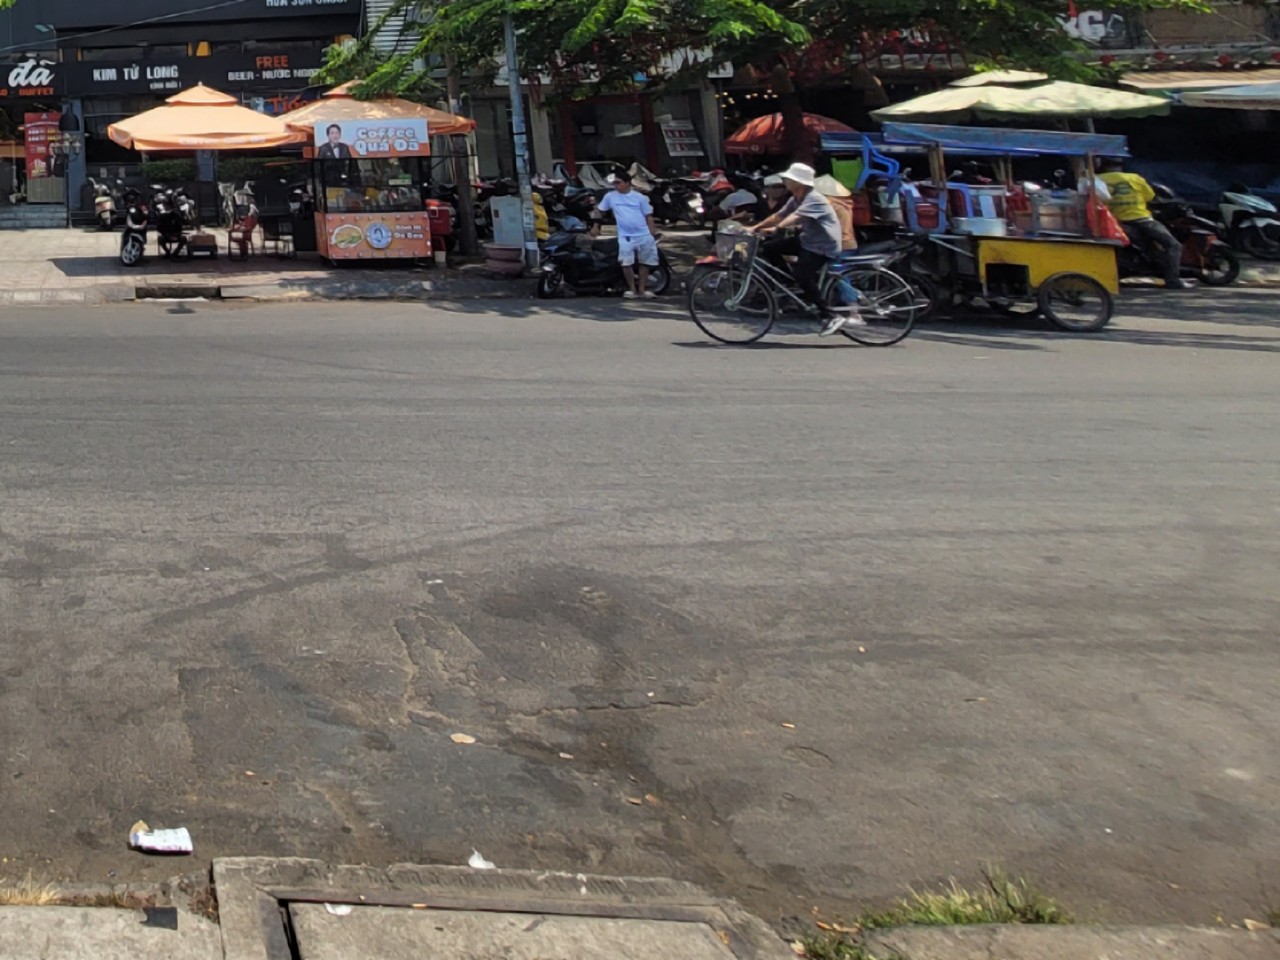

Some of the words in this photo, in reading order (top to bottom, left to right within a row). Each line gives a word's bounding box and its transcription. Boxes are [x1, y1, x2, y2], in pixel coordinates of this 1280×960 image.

[255, 55, 288, 69] FREE
[8, 58, 57, 88] đã
[93, 68, 117, 81] KIM
[146, 64, 179, 80] LONG
[357, 127, 415, 139] Coffee
